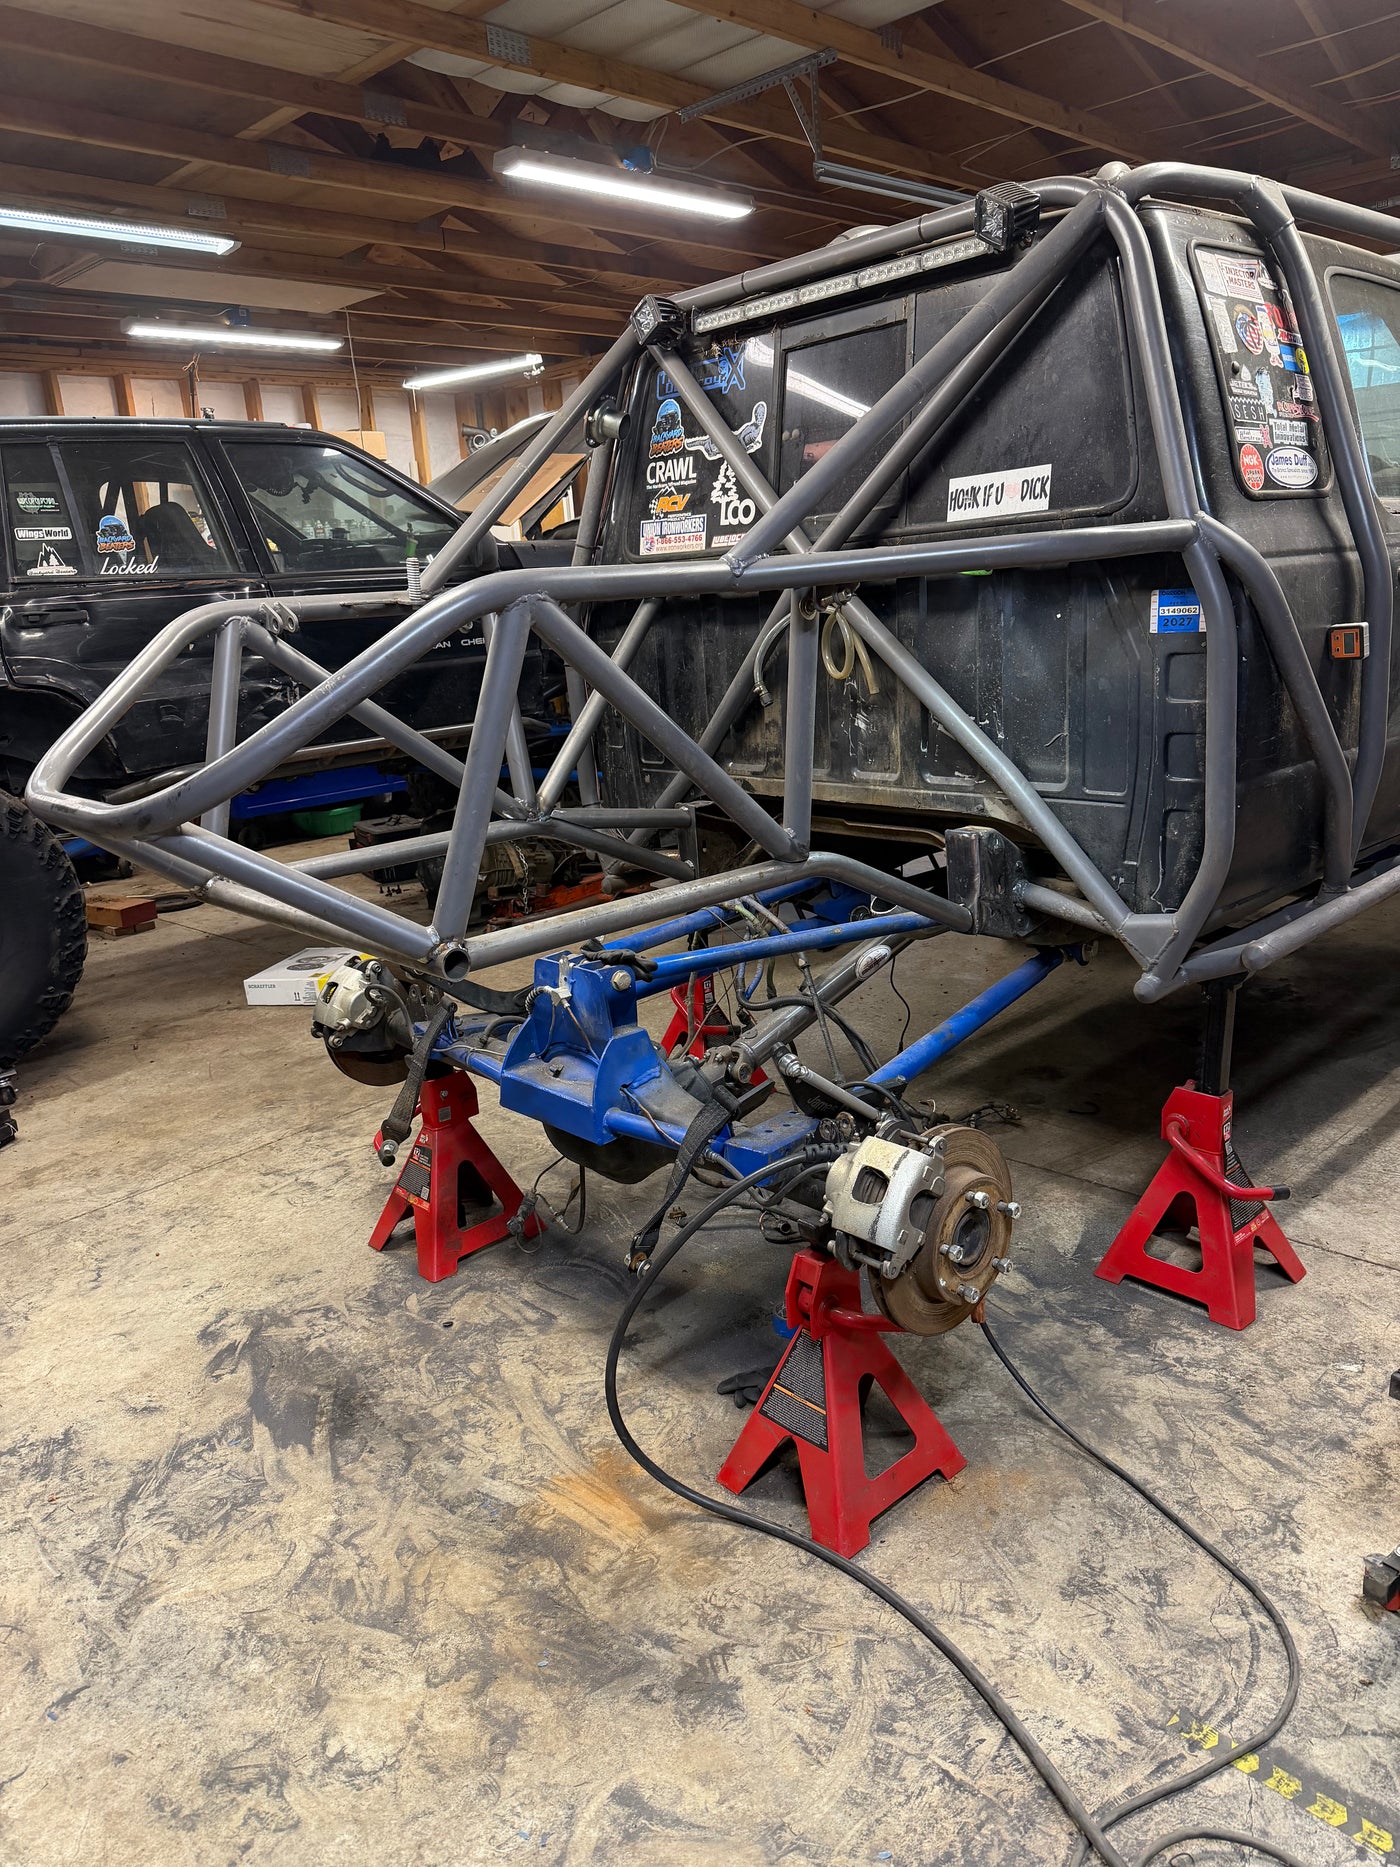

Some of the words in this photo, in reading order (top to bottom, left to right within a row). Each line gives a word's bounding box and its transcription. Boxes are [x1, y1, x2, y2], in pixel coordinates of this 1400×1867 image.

[1225, 265, 1255, 278] INJECTOR
[1228, 276, 1256, 290] MASTERS
[1234, 404, 1265, 422] SESH
[1242, 454, 1259, 466] NGK
[1271, 453, 1293, 466] James
[1293, 453, 1308, 466] Duff
[646, 456, 697, 484] CRAWL
[949, 485, 981, 512] HONK
[982, 482, 995, 508] IF
[995, 481, 1005, 506] U
[1020, 474, 1050, 502] DICK
[656, 493, 691, 513] RCV
[720, 498, 756, 526] LCO
[642, 521, 661, 537] UNION
[661, 517, 704, 536] IRONWORKERS
[656, 534, 703, 545] 1-866-553-4766
[712, 533, 745, 545] LUBELOC
[99, 541, 135, 551] BEATERS
[100, 555, 159, 575] Locked
[1163, 617, 1193, 627] 2027
[461, 637, 485, 647] CHE
